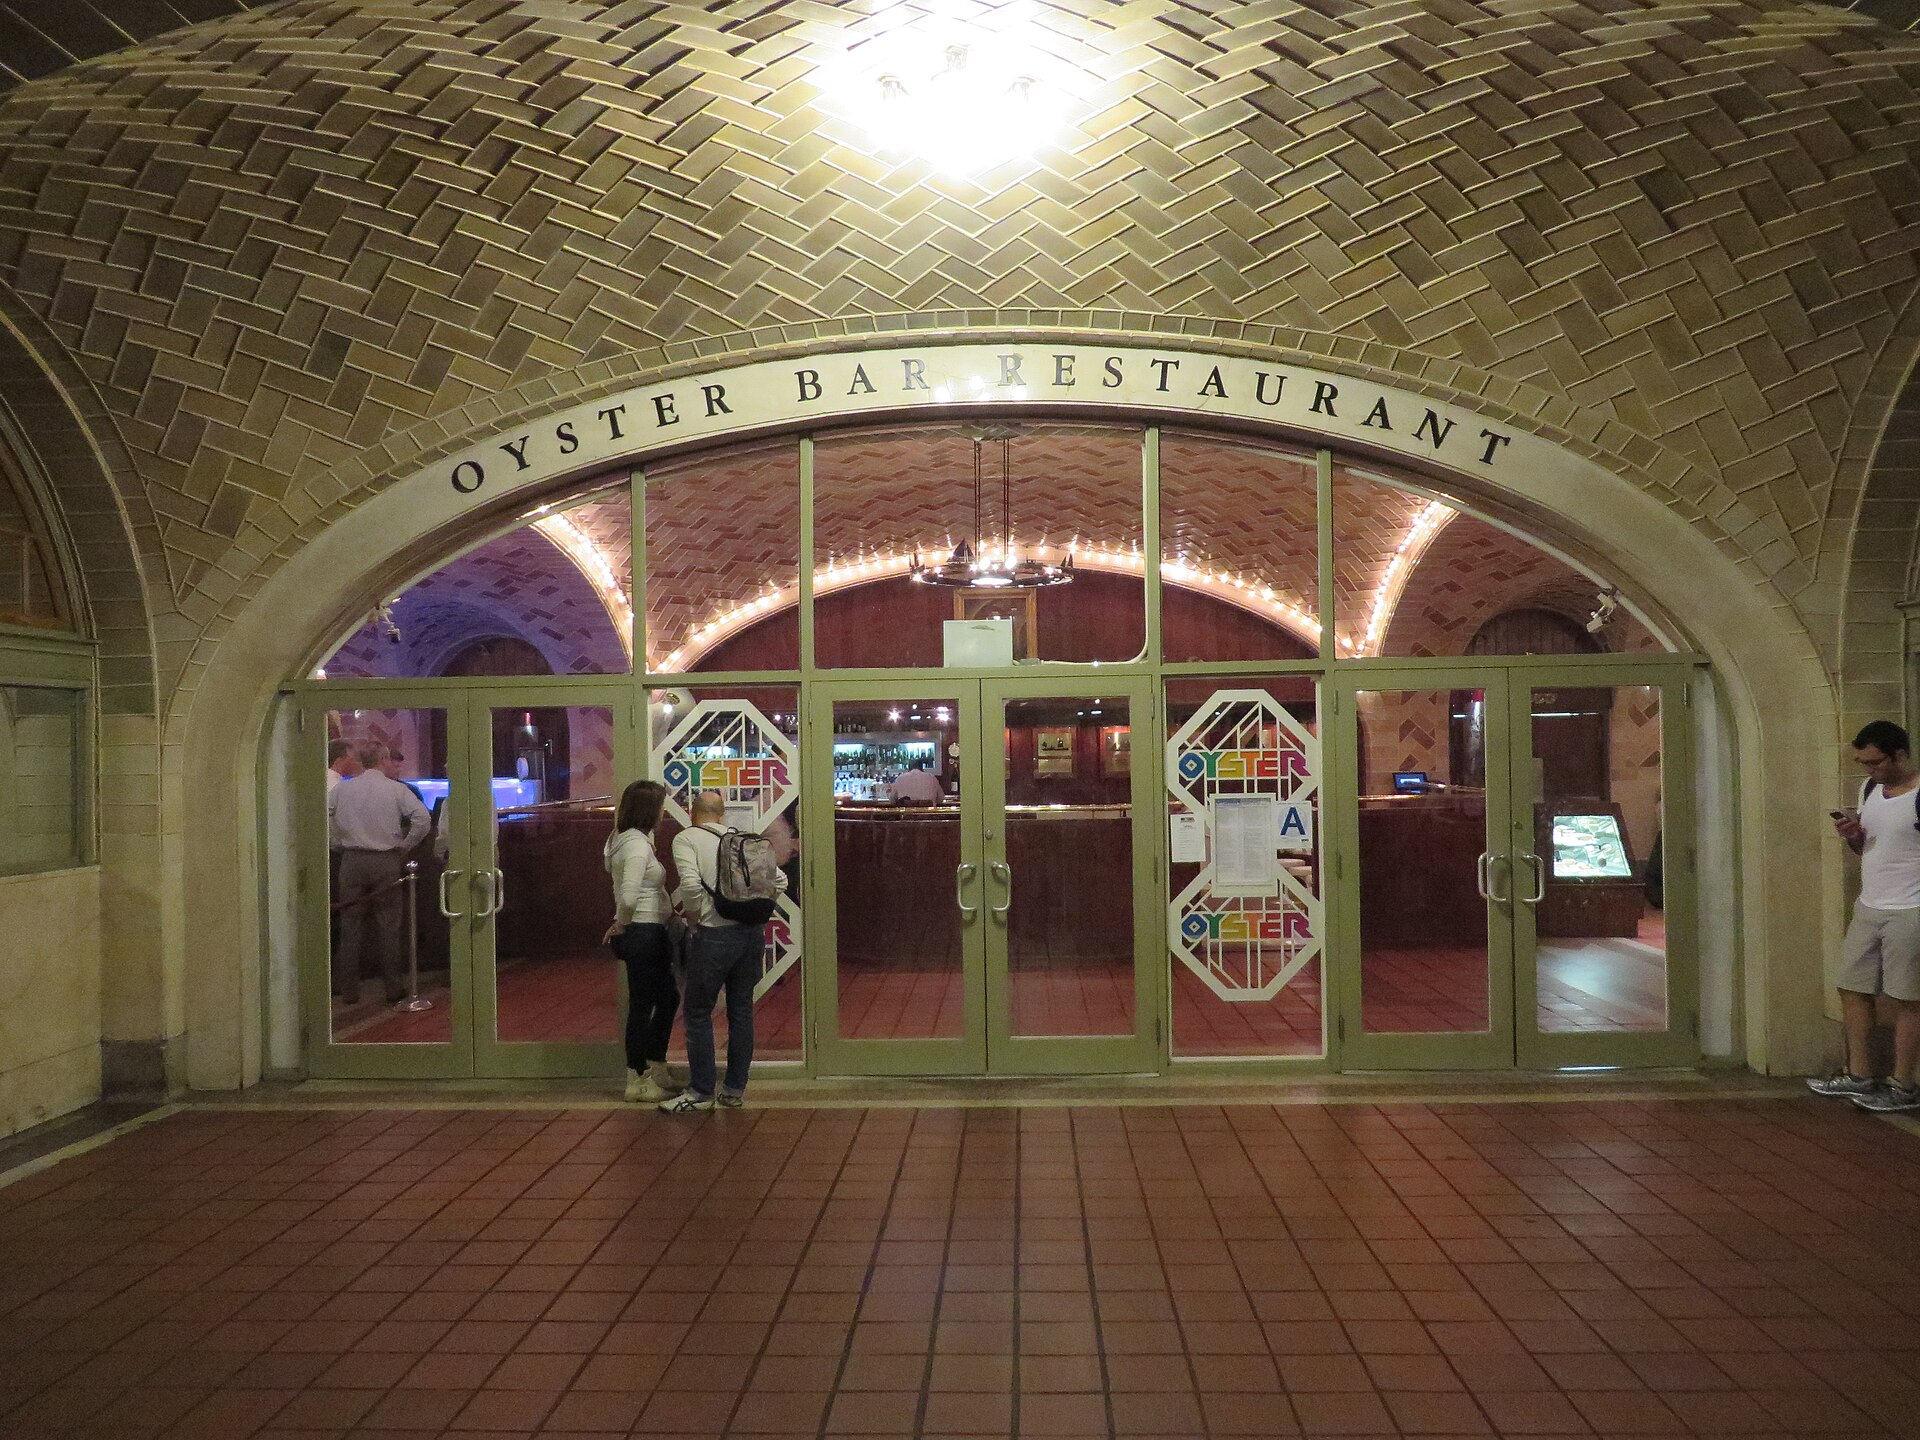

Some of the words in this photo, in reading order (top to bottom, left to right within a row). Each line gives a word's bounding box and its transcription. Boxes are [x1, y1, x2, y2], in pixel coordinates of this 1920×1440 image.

[450, 384, 733, 494] OYSTER
[794, 357, 931, 402] BAR
[997, 353, 1511, 466] RESTAURANT
[663, 760, 793, 787] OYSTER
[1178, 751, 1312, 779] OYSTER
[1280, 806, 1306, 836] A
[1181, 913, 1315, 940] OYSTER
